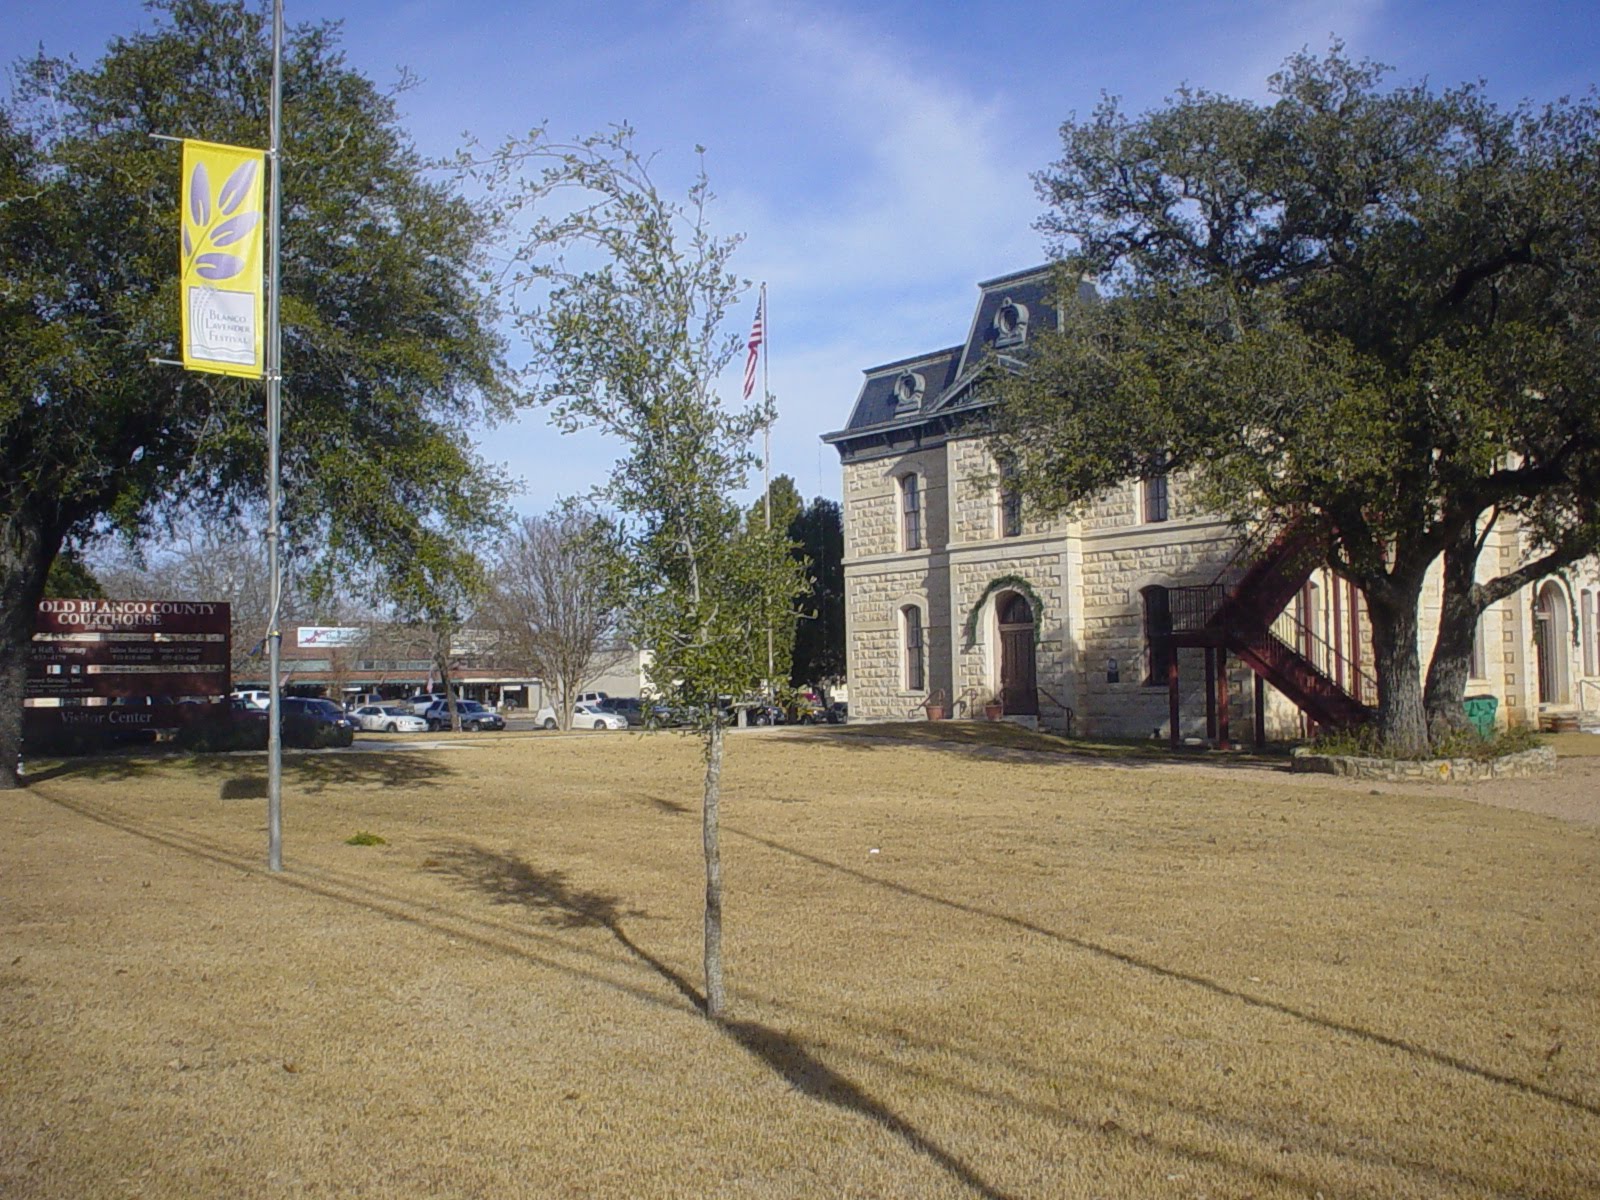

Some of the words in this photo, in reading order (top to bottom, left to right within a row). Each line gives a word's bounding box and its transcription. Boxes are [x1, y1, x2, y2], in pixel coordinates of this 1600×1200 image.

[209, 309, 246, 323] BLANCO
[205, 318, 251, 332] LAVENDER
[209, 331, 248, 343] FESTIVAL
[39, 601, 76, 613] OLD
[80, 601, 147, 614] BLANCO
[151, 602, 216, 615] COUNTY
[57, 613, 162, 626] COURTHOUSE
[61, 711, 105, 723] Visitor
[109, 710, 153, 723] Center
